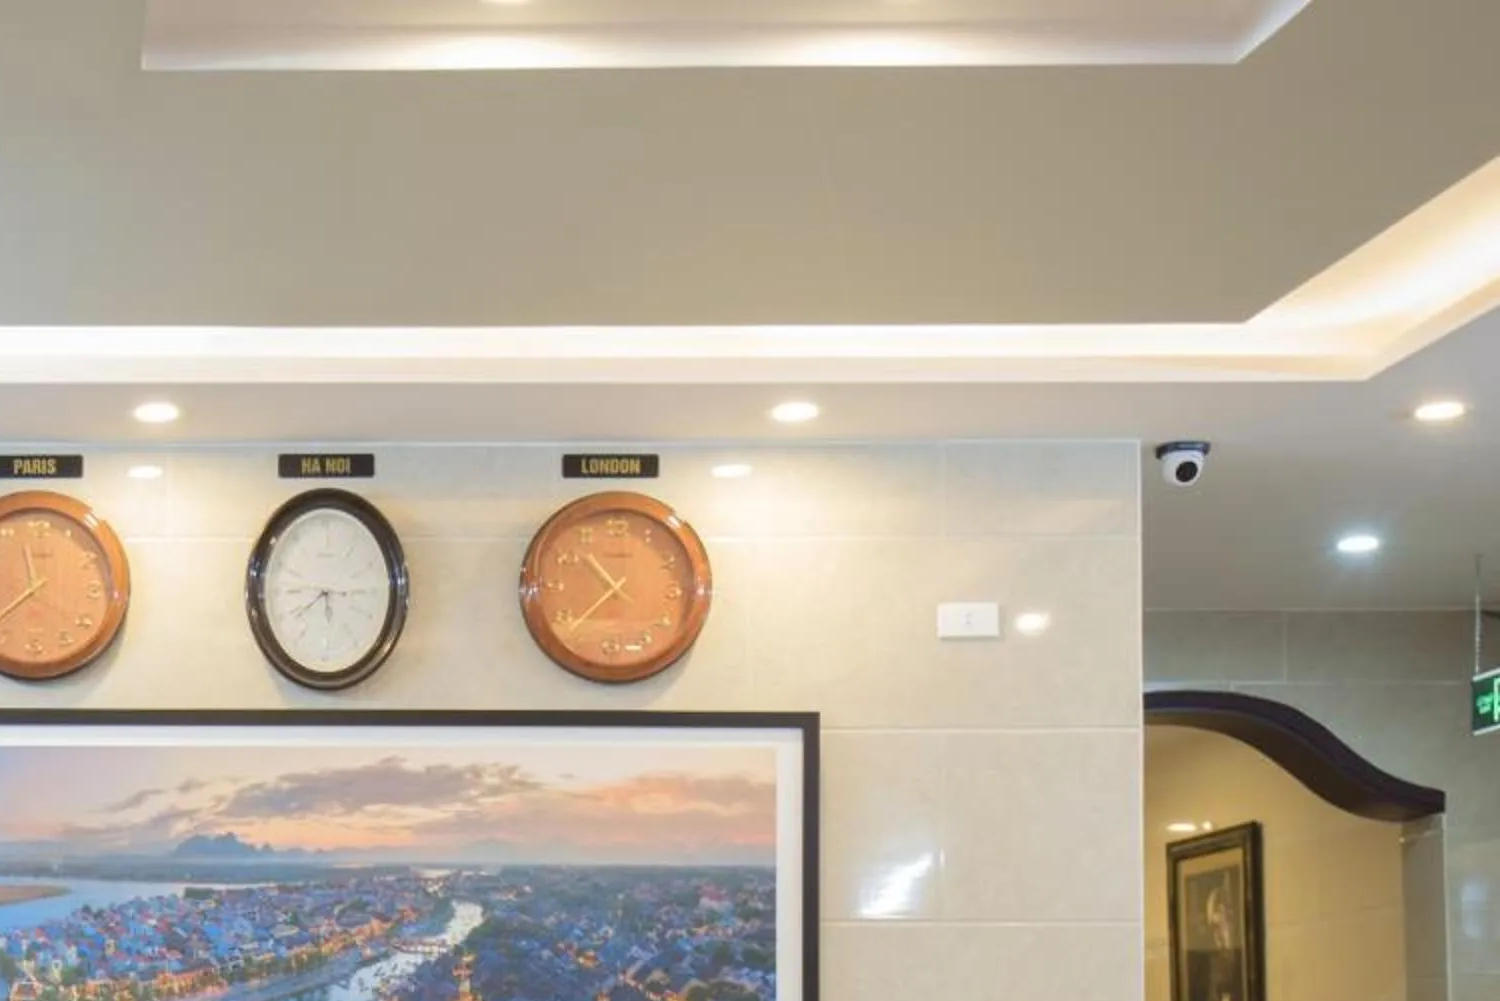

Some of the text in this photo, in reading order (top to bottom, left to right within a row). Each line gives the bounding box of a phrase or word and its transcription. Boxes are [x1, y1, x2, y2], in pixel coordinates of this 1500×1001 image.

[12, 458, 57, 475] PARIS
[301, 457, 351, 474] HA NOI
[580, 458, 641, 474] LONDON
